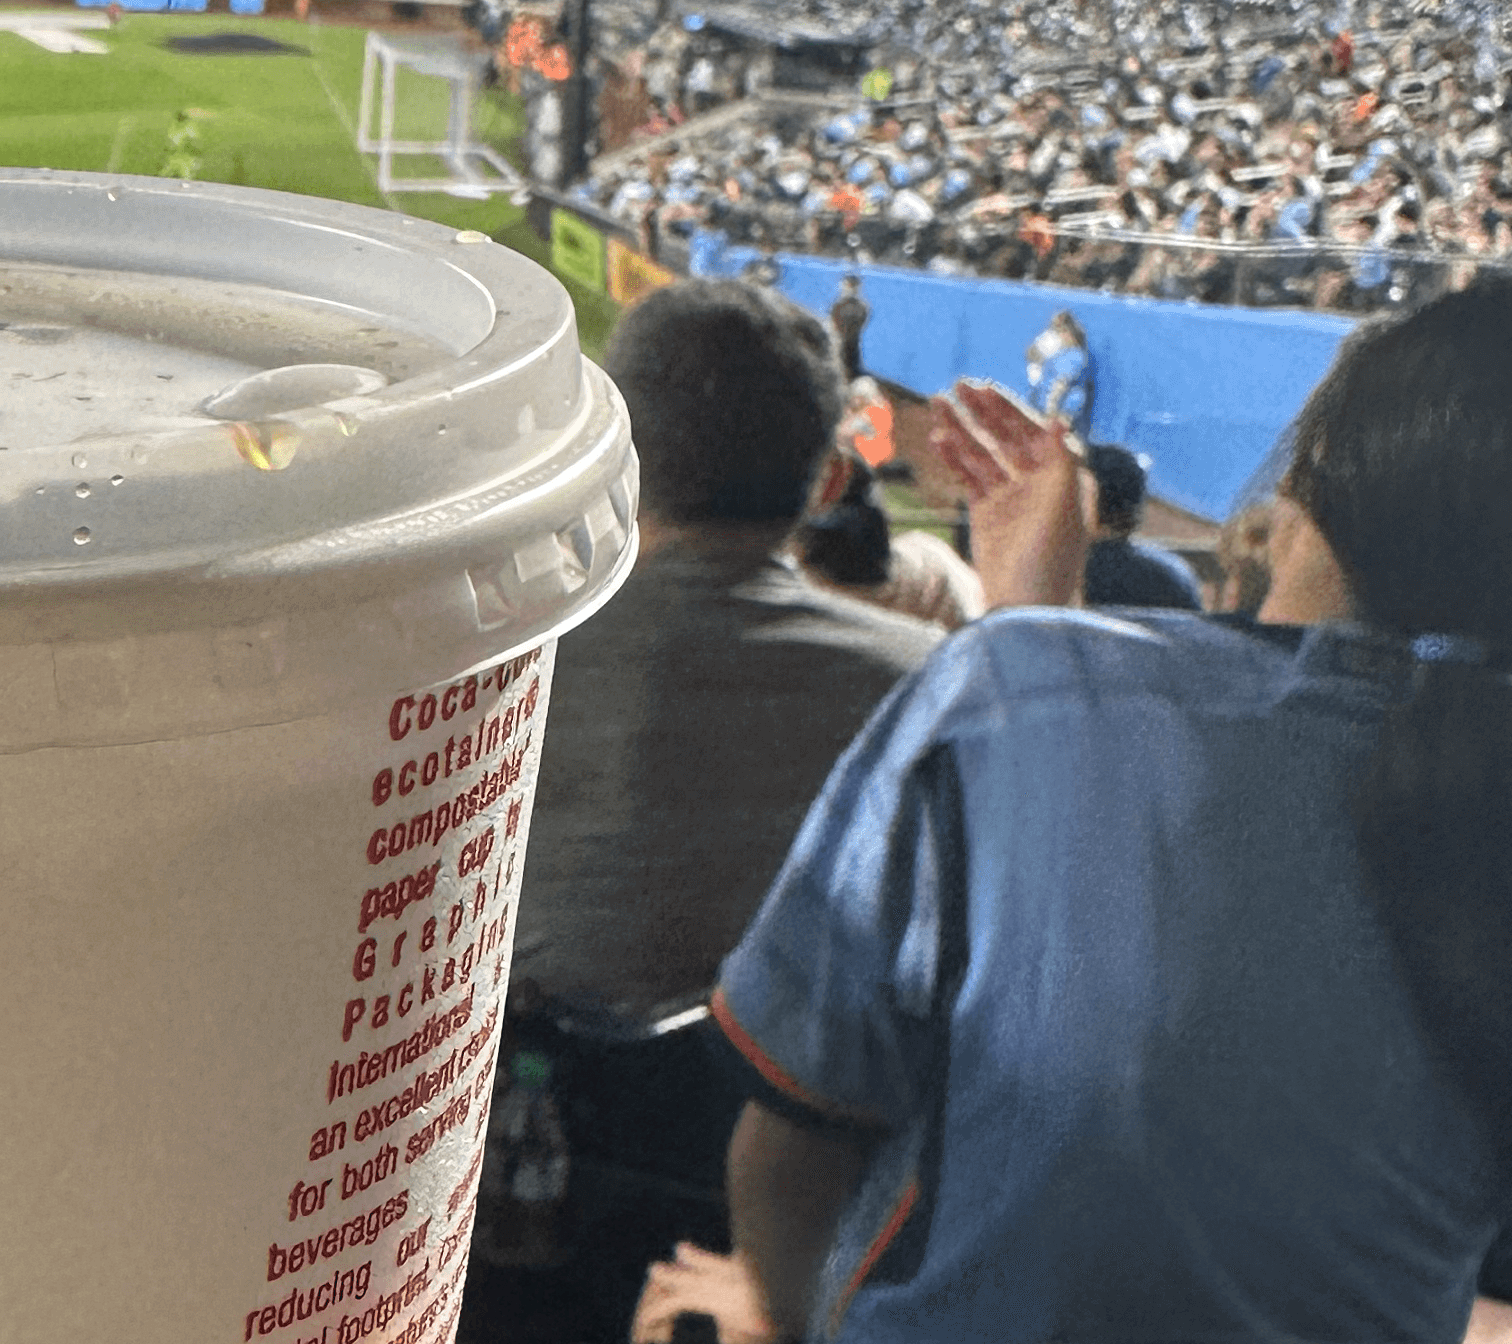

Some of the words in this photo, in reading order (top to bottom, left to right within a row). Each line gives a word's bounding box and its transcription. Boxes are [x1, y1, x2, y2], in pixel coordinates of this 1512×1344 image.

[357, 859, 442, 934] paper
[309, 1120, 347, 1161] an
[288, 1177, 334, 1223] for
[340, 1142, 399, 1201] both
[266, 1189, 410, 1282] beverages
[243, 1259, 373, 1343] reducing
